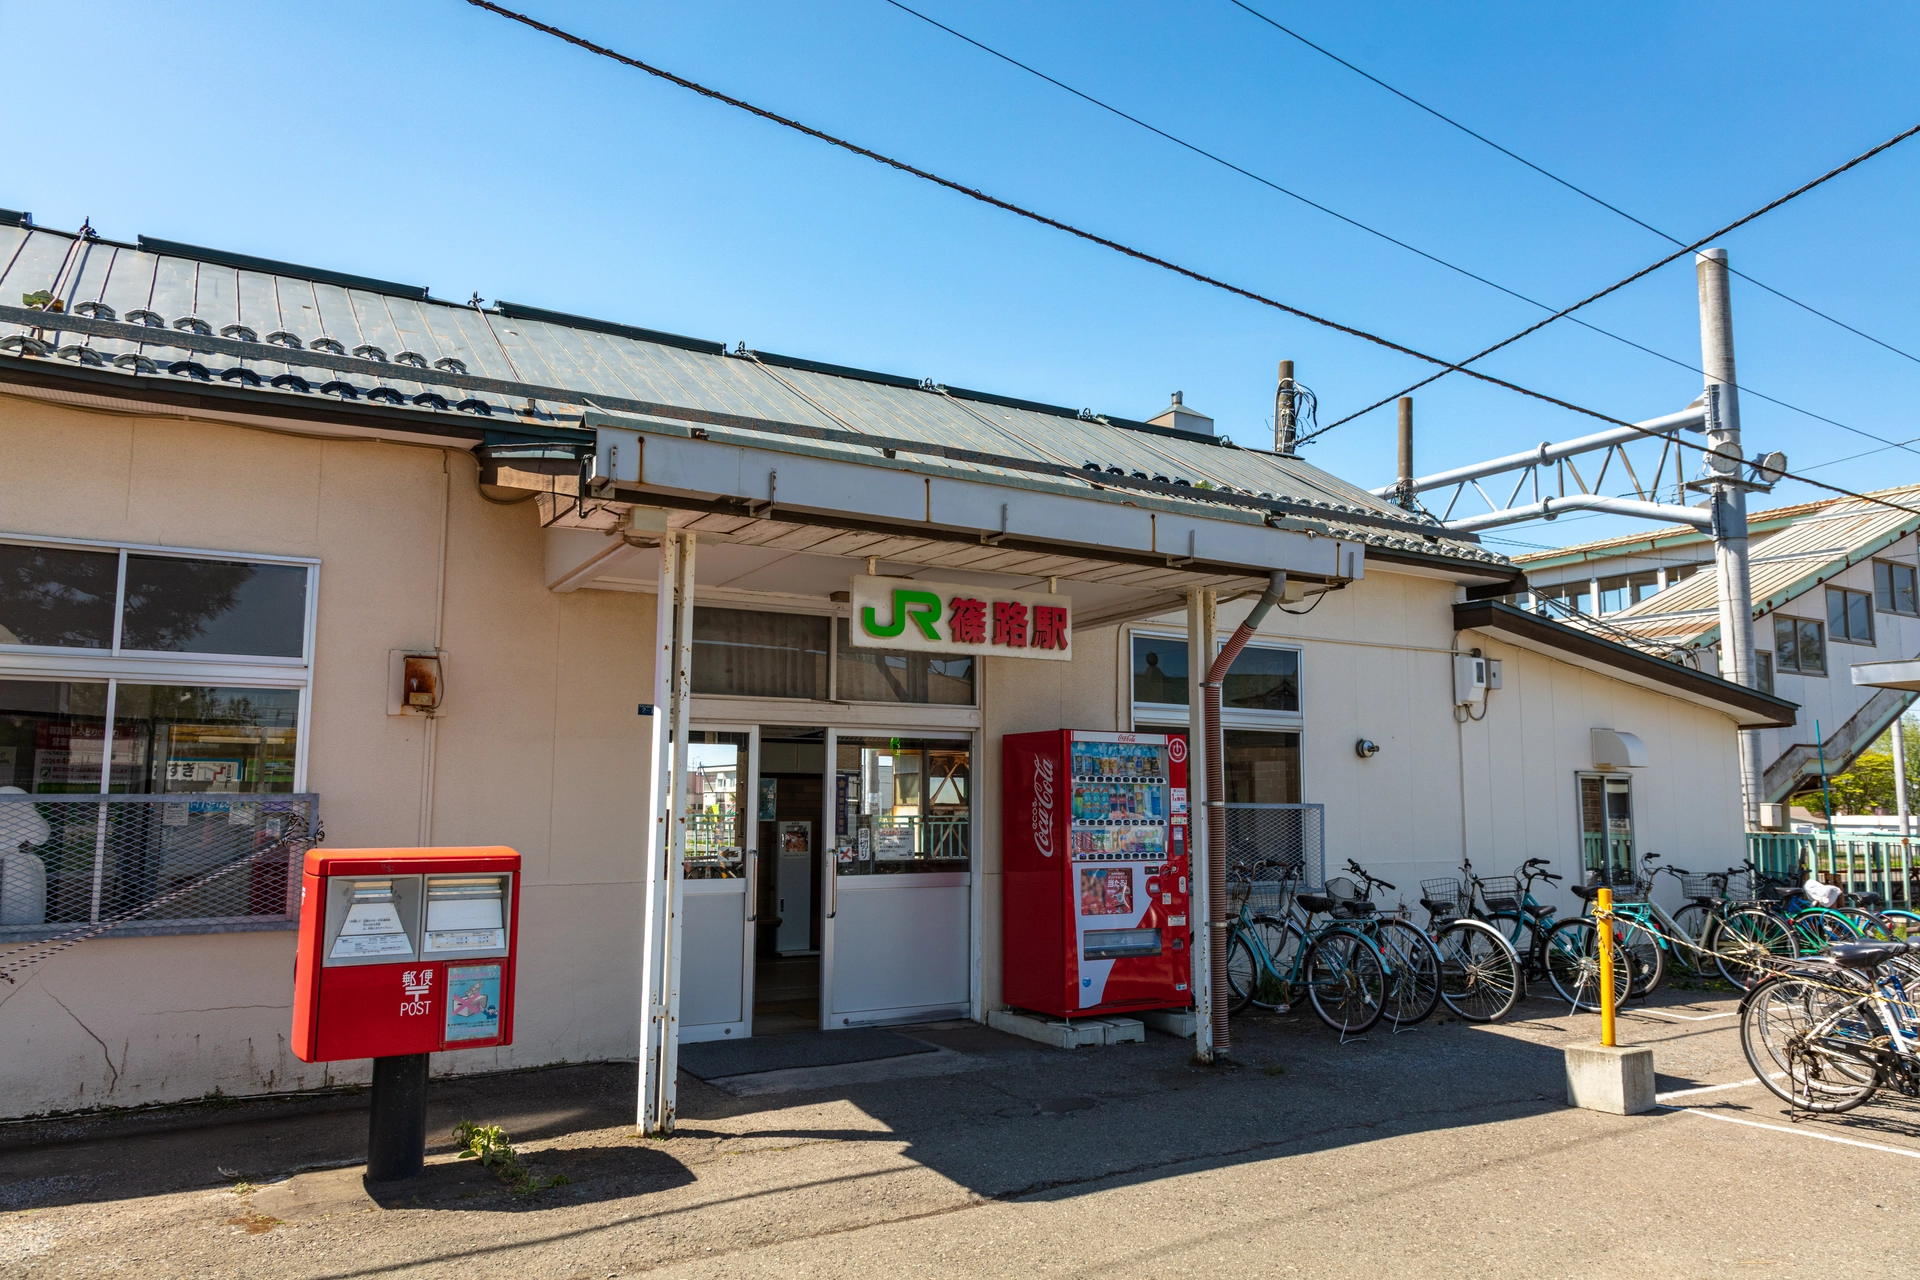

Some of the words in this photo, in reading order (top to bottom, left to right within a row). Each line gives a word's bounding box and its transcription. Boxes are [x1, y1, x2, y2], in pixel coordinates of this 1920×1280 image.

[862, 590, 942, 641] JR
[949, 597, 1068, 650] 篠路駅
[1034, 753, 1054, 857] Coca-Cola
[402, 969, 434, 988] 郵便
[400, 1000, 432, 1017] POST
